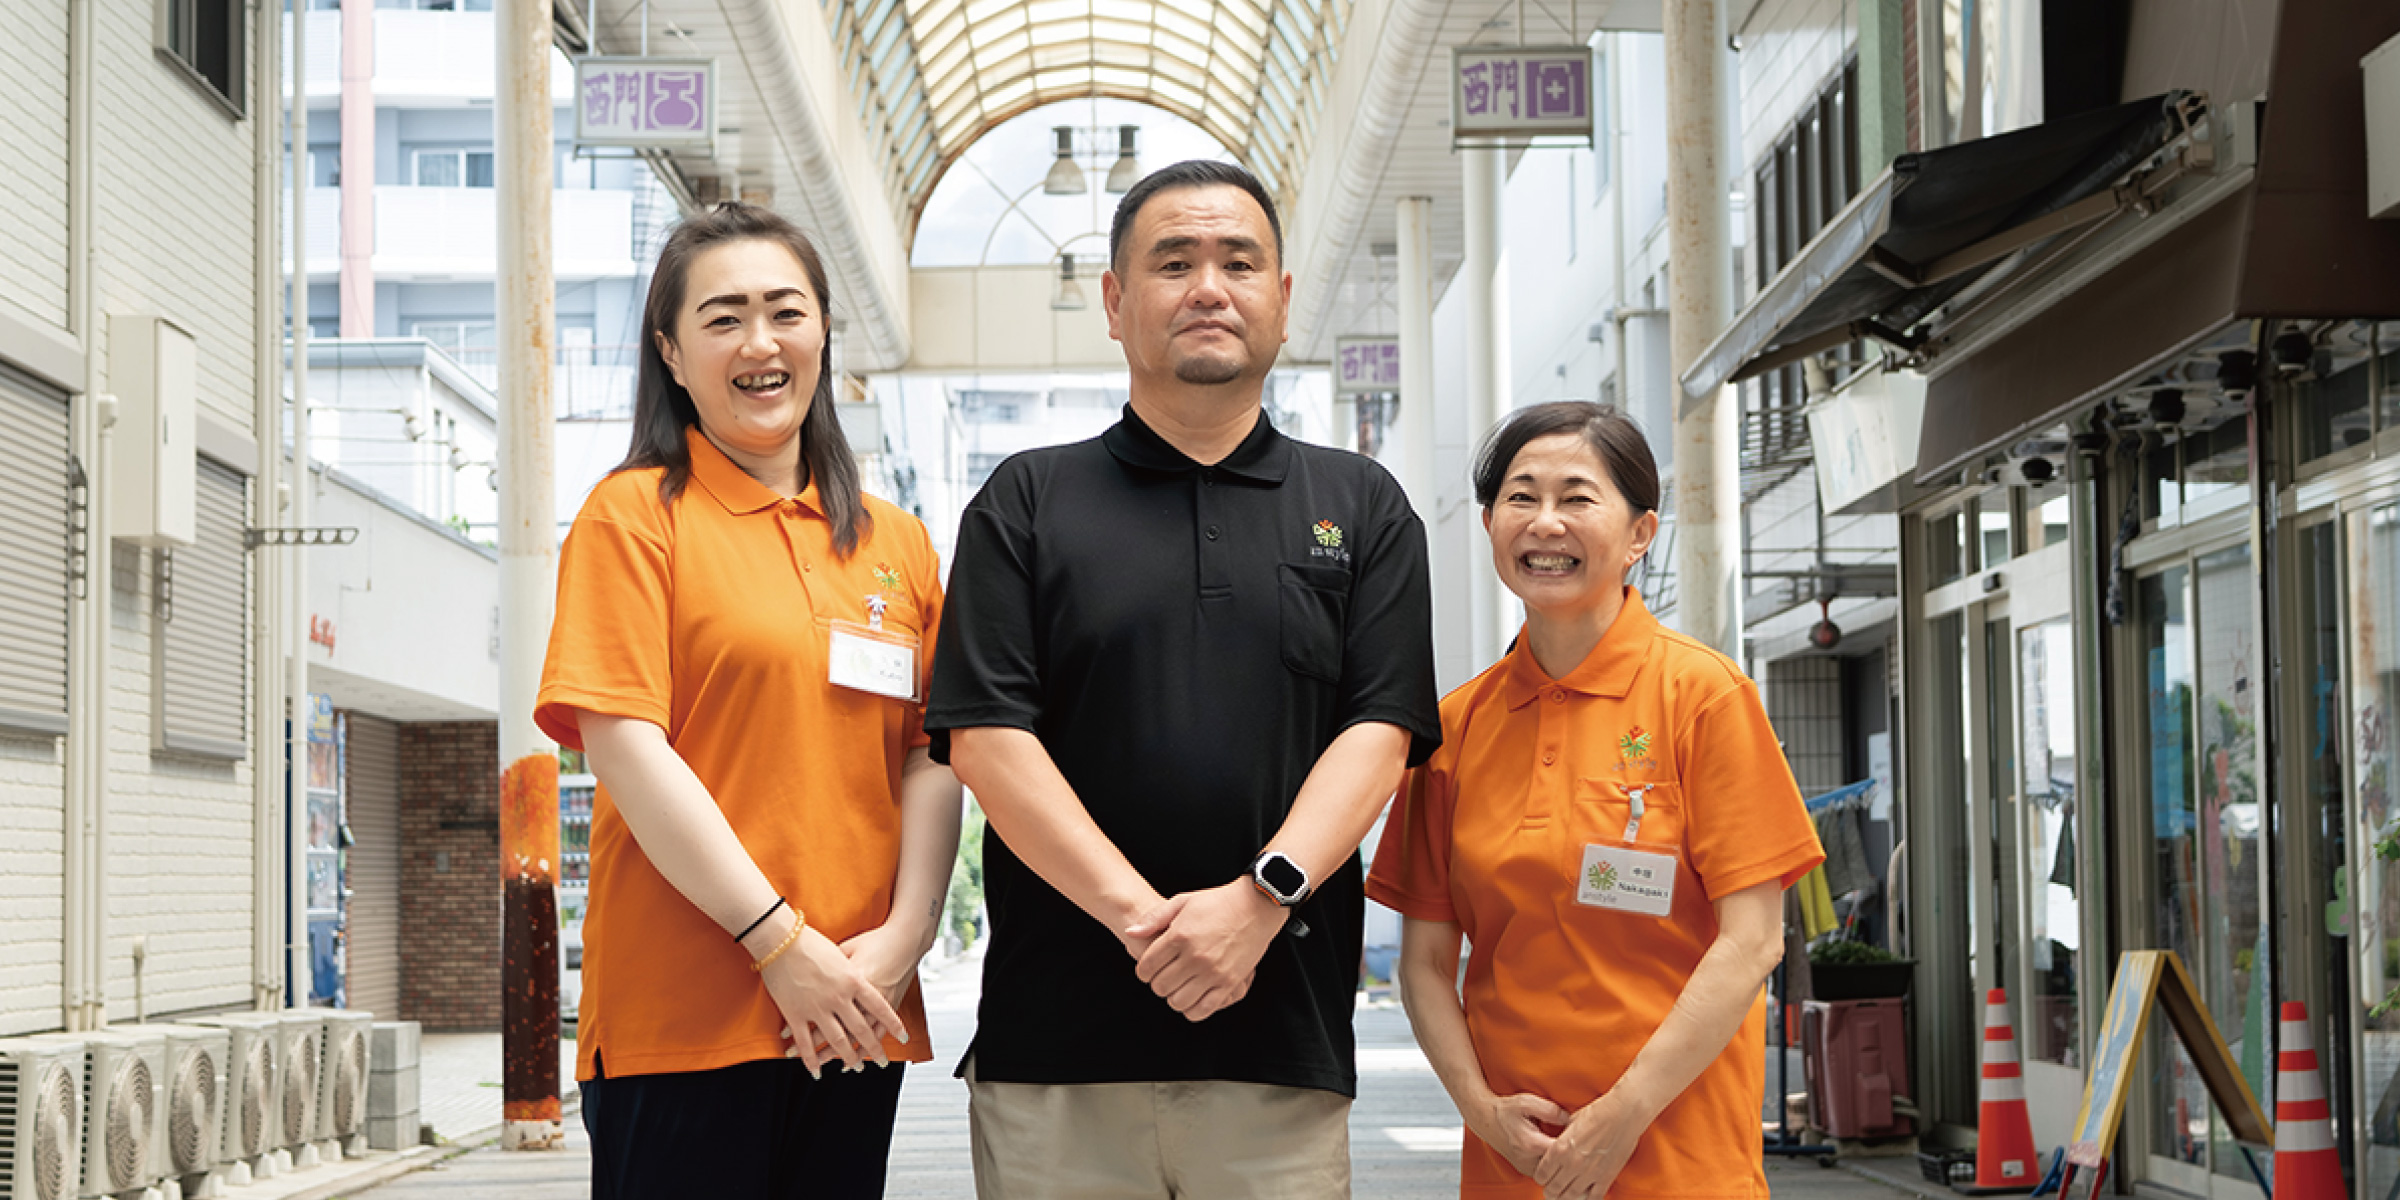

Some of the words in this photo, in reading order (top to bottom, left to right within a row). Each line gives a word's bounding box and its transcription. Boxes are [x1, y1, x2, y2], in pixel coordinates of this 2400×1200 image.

[583, 71, 640, 130] 西門
[1461, 60, 1519, 118] 西門
[1341, 344, 1378, 382] 西門
[1618, 881, 1669, 899] Nakagaki
